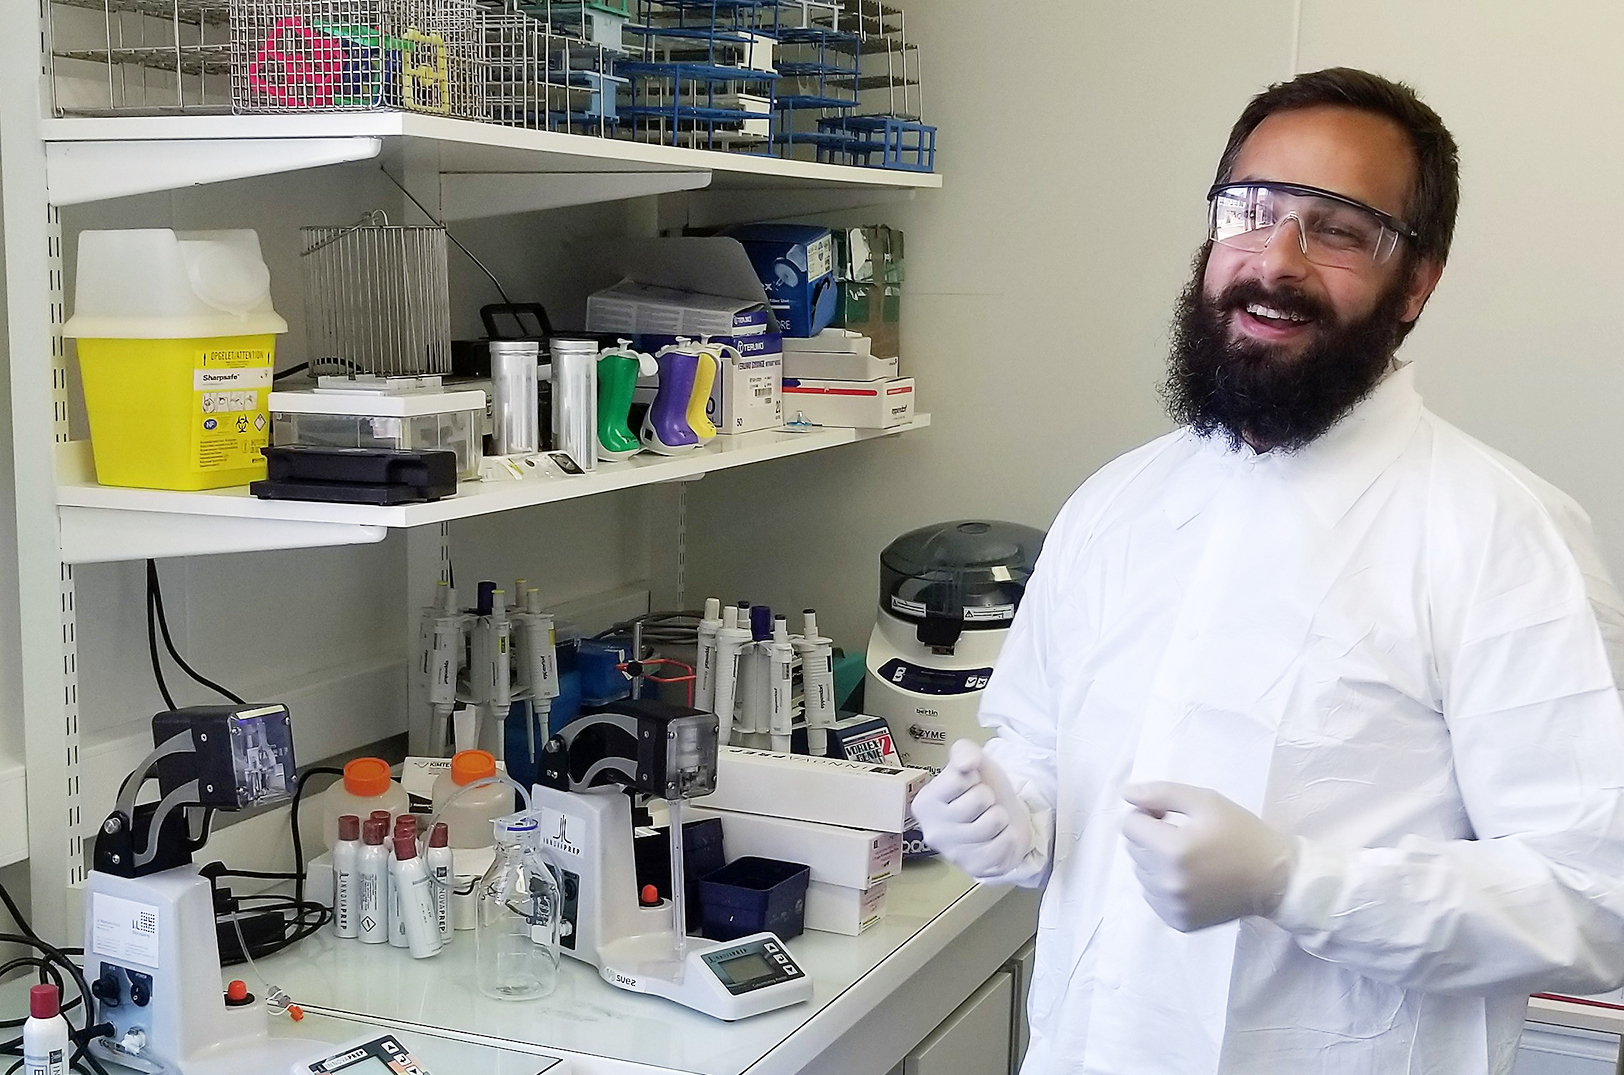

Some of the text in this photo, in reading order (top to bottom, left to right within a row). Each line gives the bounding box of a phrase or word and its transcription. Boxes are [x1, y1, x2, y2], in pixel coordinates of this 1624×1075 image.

[203, 373, 240, 382] Sharpsafe
[916, 707, 939, 717] bertin
[616, 974, 637, 987] suez
